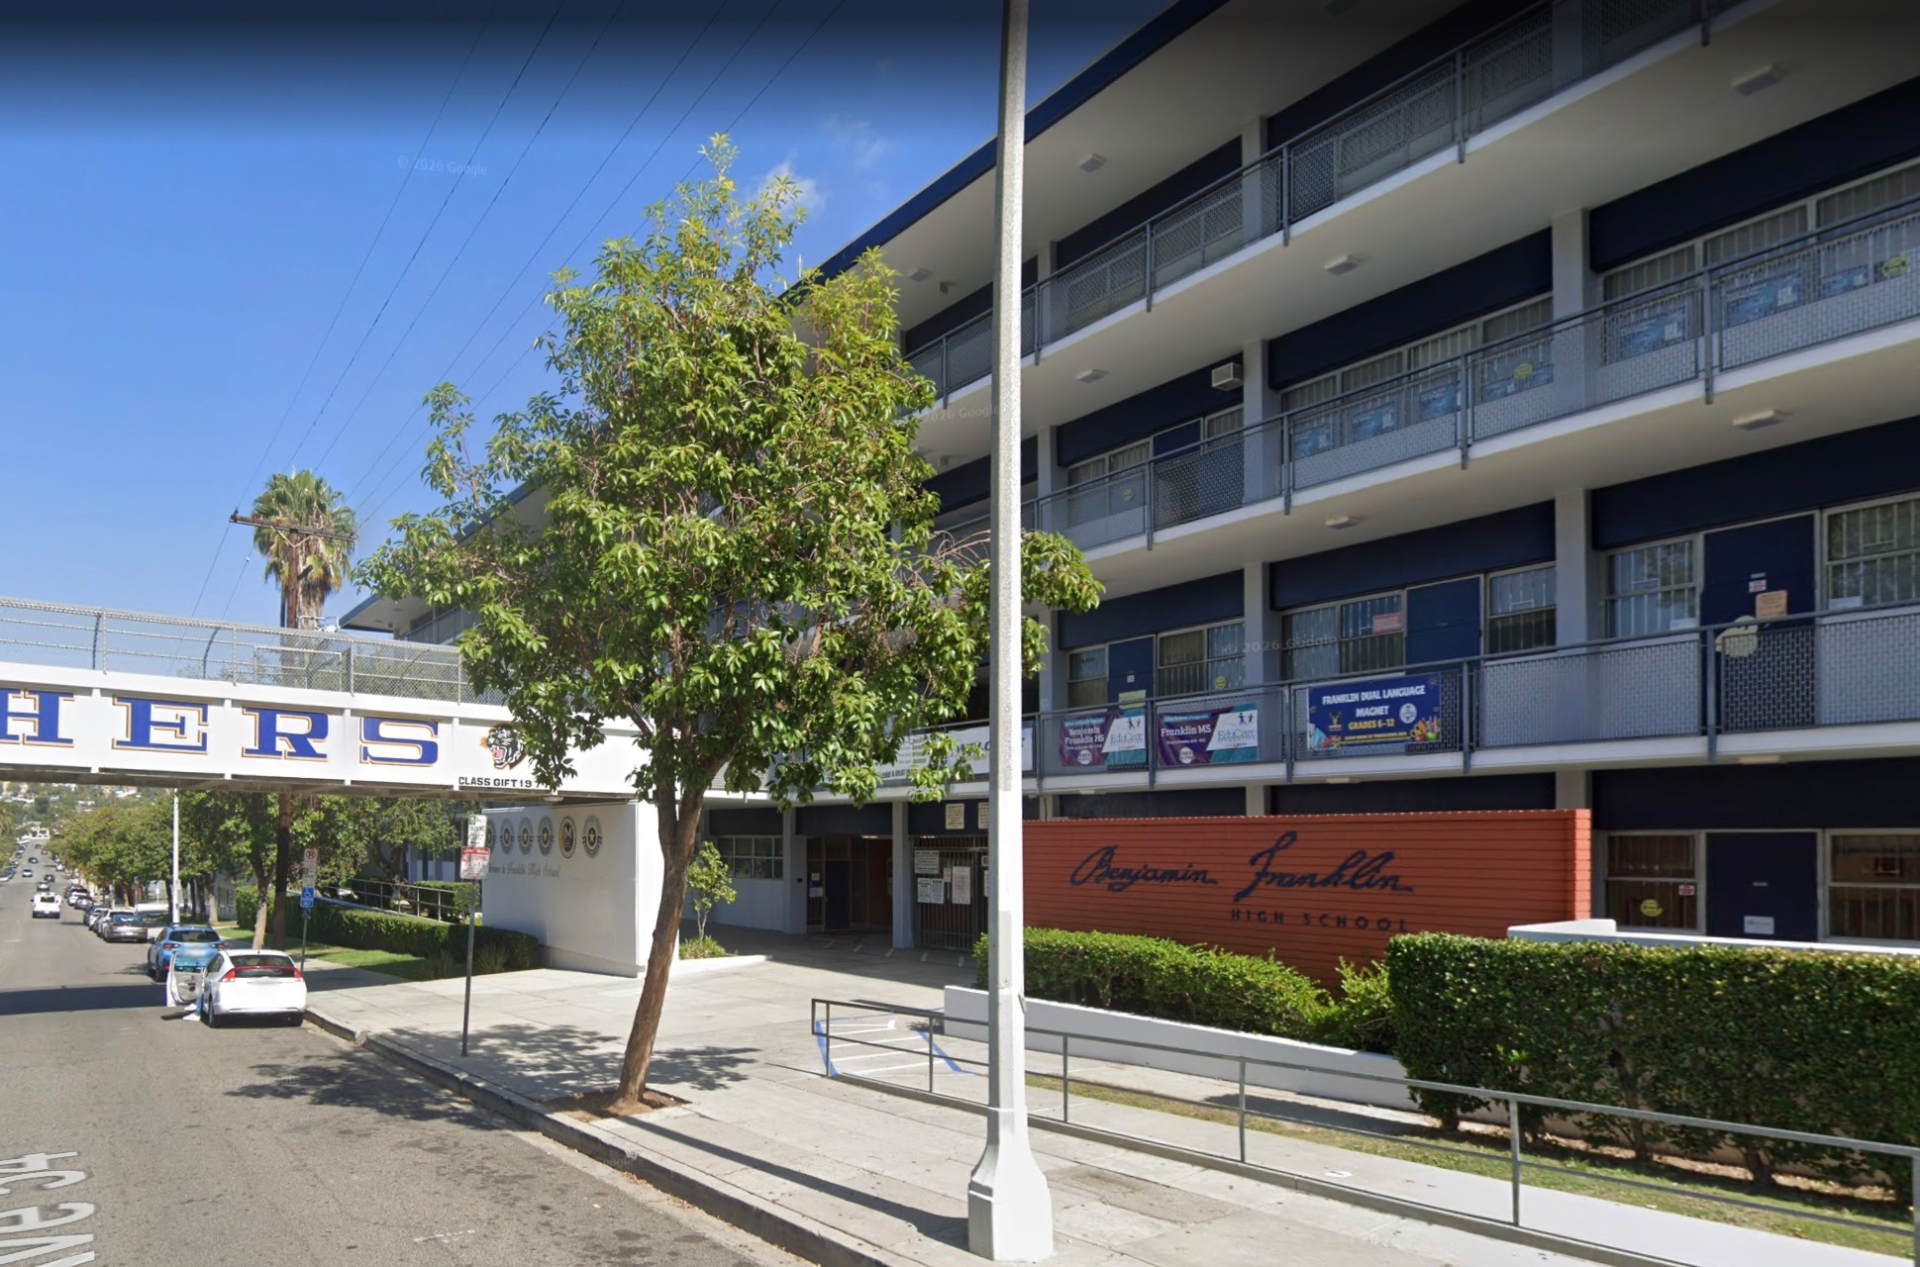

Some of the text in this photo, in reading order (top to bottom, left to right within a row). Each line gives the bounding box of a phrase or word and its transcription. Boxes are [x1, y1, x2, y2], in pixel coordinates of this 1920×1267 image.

[1322, 685, 1426, 705] FRANKLIN DUAL LANGUAGE
[1356, 706, 1390, 717] MAGNET
[0, 686, 440, 768] HERS
[1161, 724, 1212, 736] Franklin MS
[1348, 719, 1377, 730] GRADES
[1069, 726, 1100, 737] Benjamin
[1218, 729, 1256, 740] EduCare
[1064, 734, 1093, 744] Franklin
[1111, 732, 1144, 744] EduCare
[459, 776, 491, 786] CLASS
[493, 778, 518, 787] GIFT
[1070, 830, 1414, 903] Benjamin Franklin
[1231, 908, 1408, 933] HIGH SCHOOL
